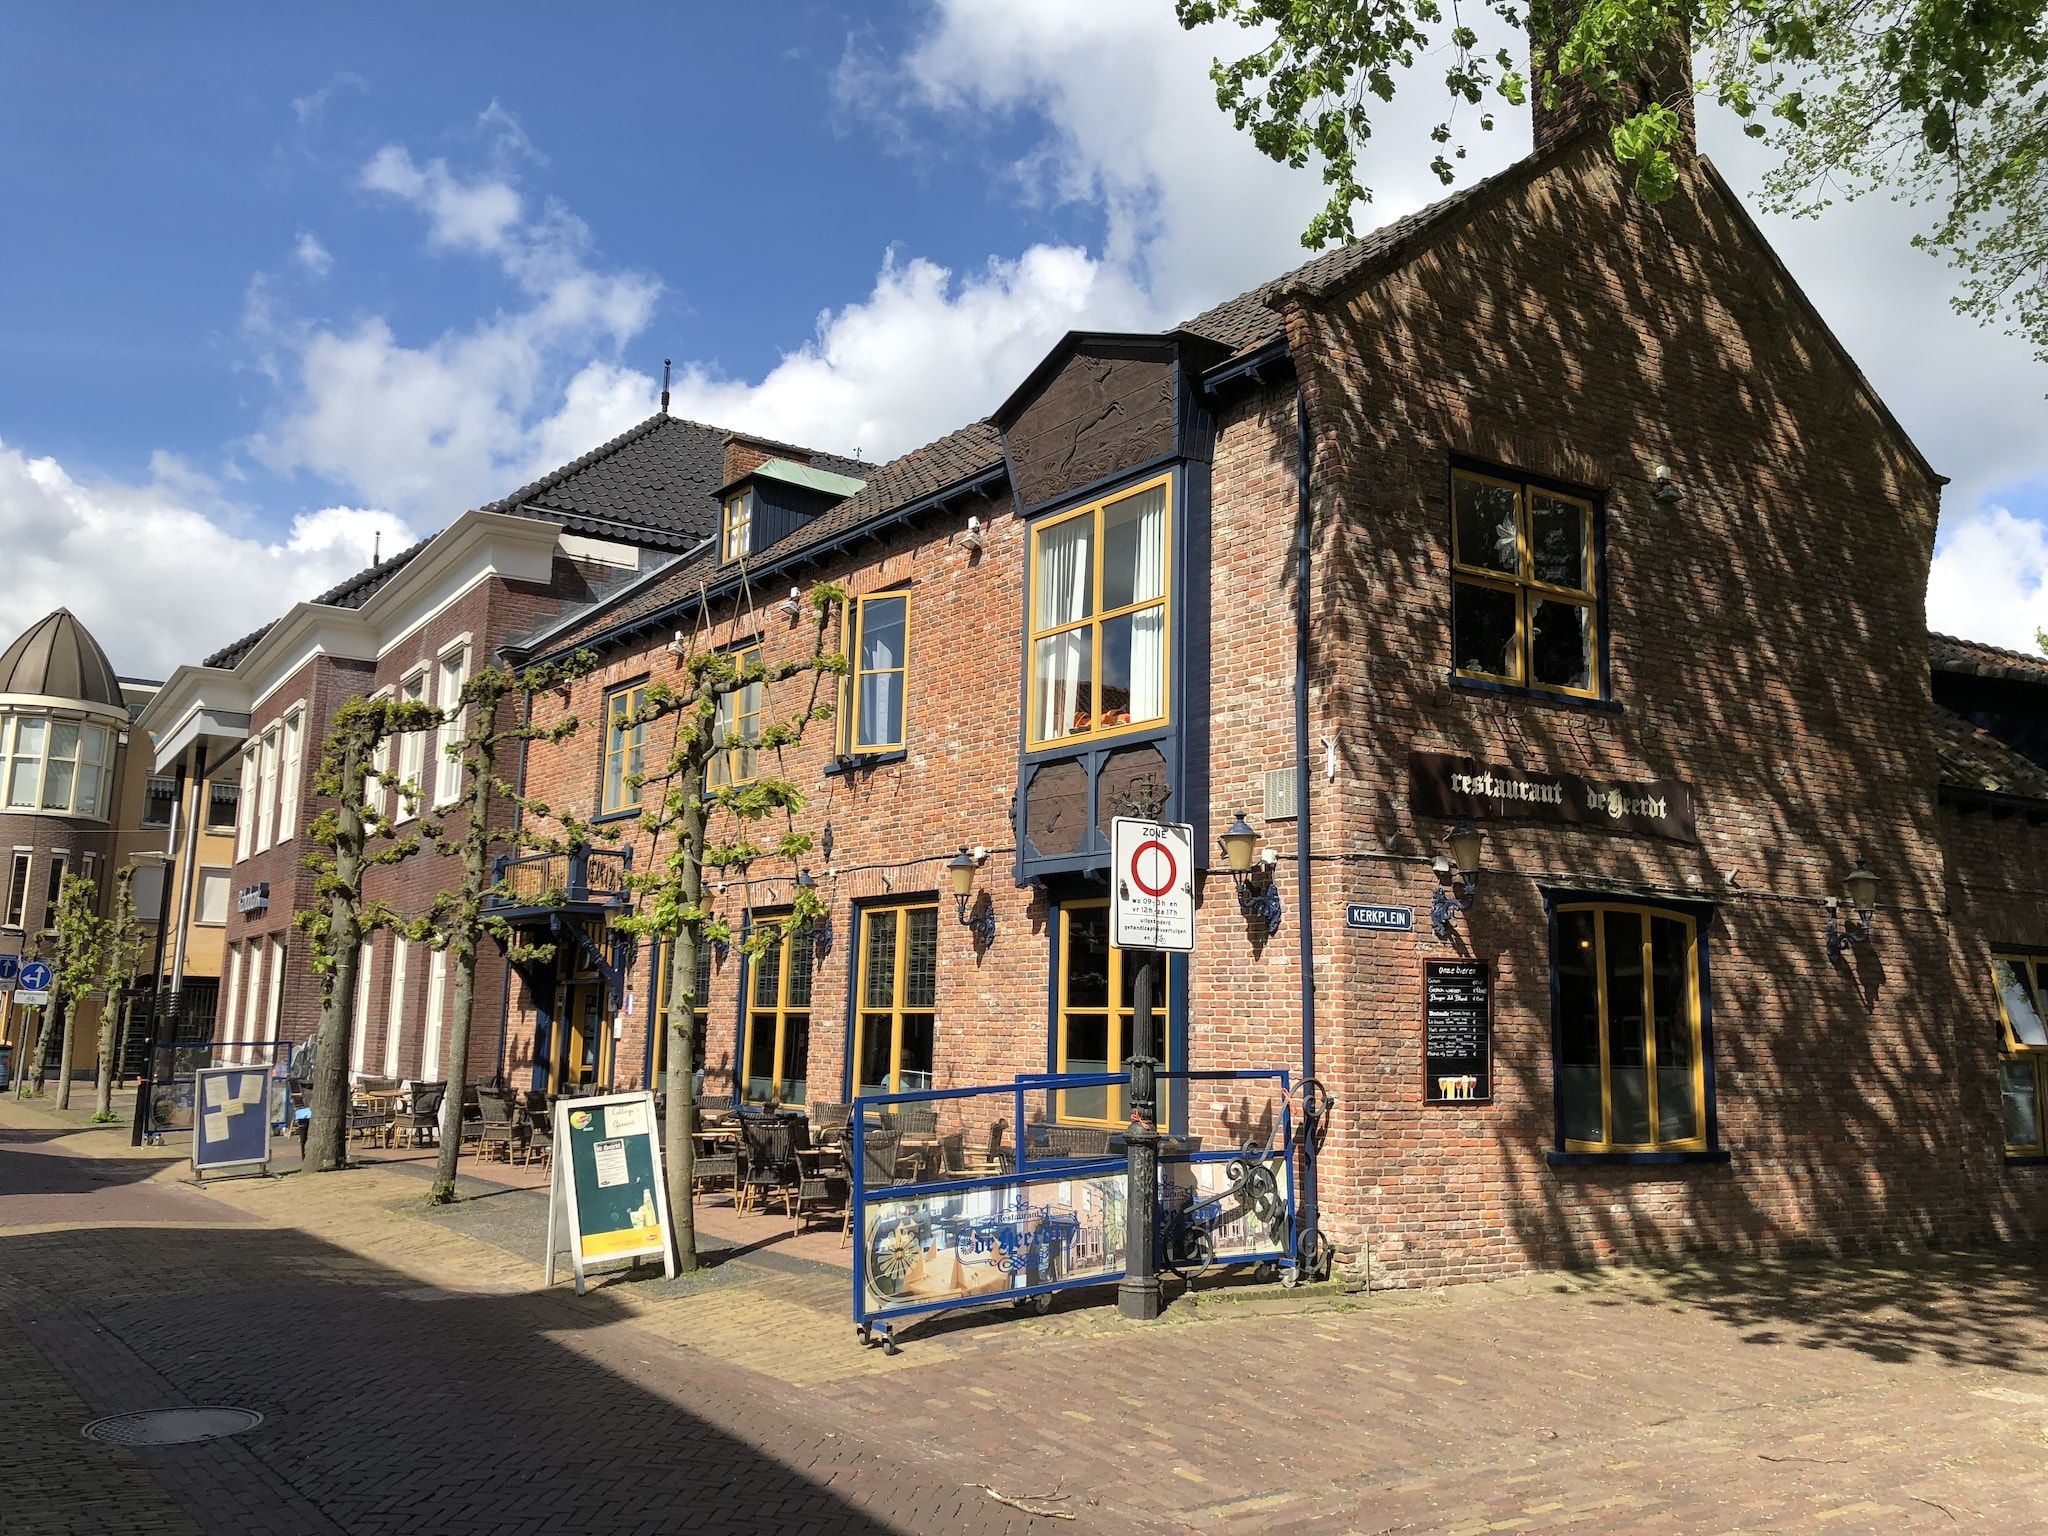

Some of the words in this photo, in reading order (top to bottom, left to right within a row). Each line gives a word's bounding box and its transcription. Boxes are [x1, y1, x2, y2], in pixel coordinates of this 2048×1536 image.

[1450, 770, 1564, 805] restaurant
[1142, 827, 1167, 839] ZONE
[1353, 908, 1406, 925] KERKPLEIN
[997, 1210, 1040, 1223] Restaurant
